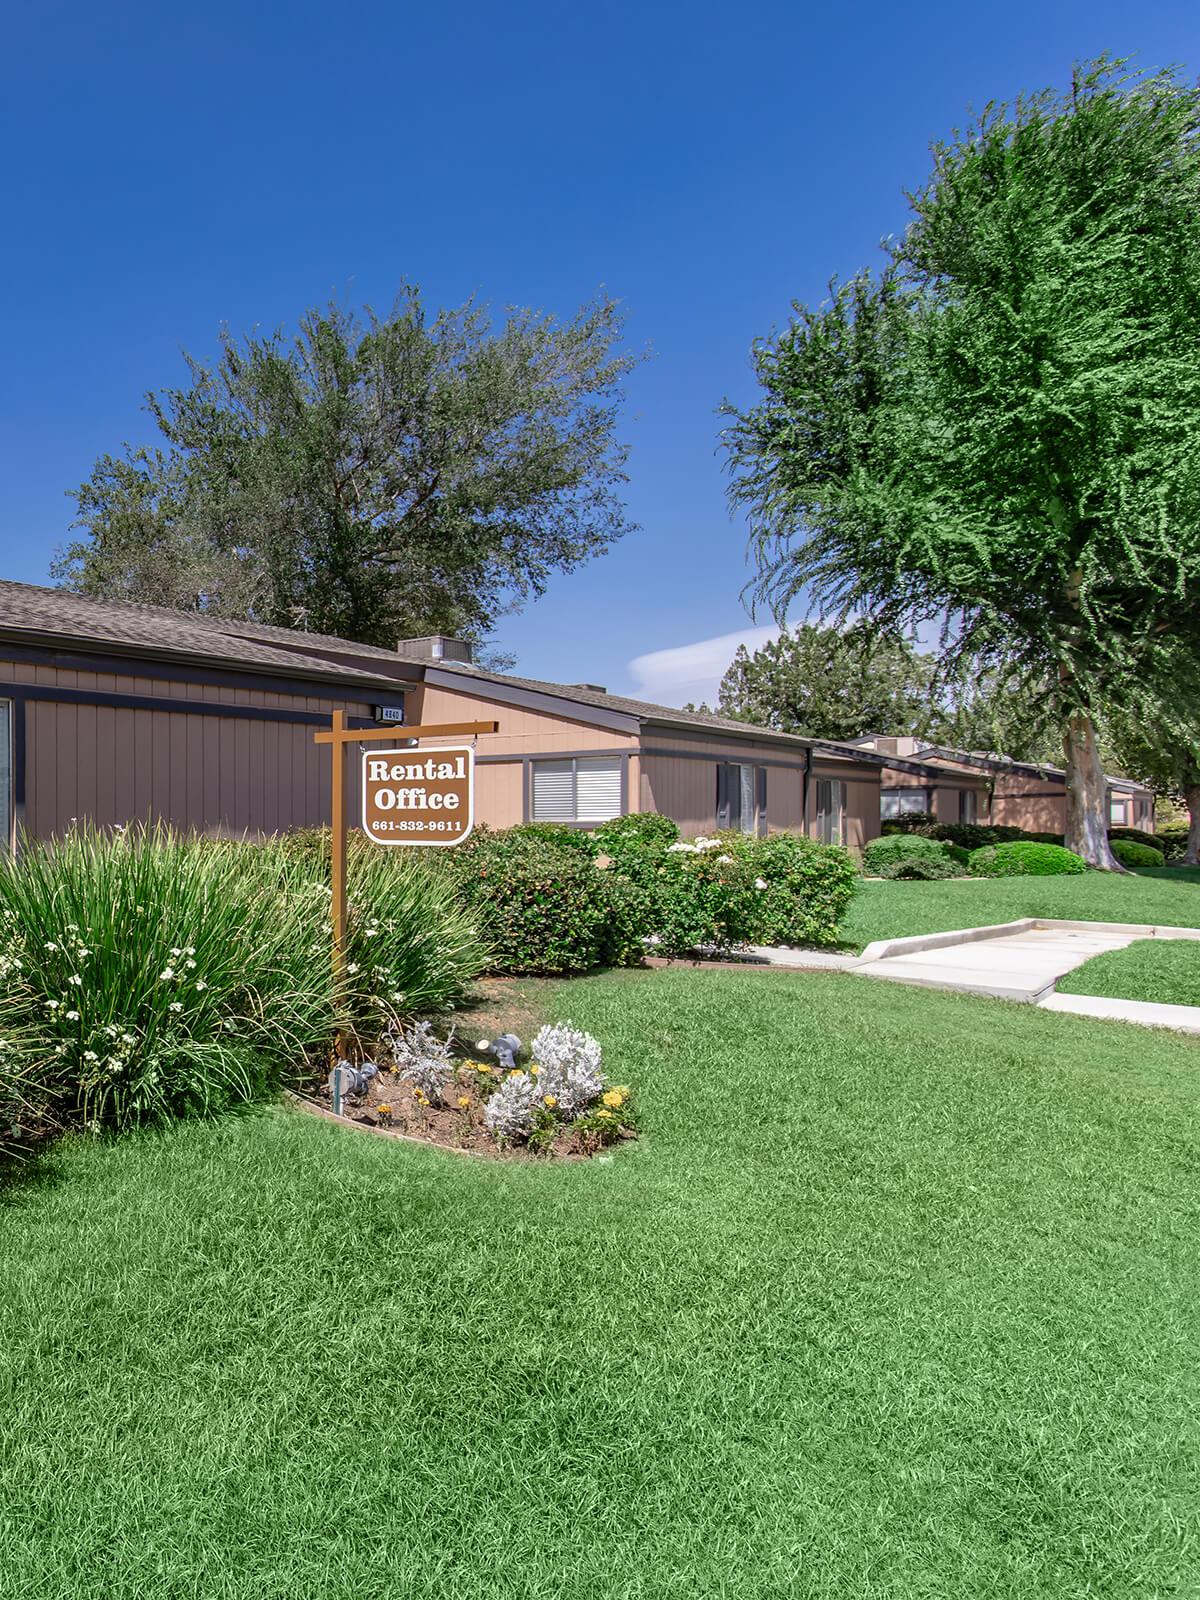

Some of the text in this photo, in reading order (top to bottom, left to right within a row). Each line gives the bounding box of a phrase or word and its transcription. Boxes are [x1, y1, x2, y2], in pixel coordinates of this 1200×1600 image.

[368, 757, 466, 781] Rental
[374, 788, 460, 810] Office
[372, 820, 462, 831] 661-832-9611
